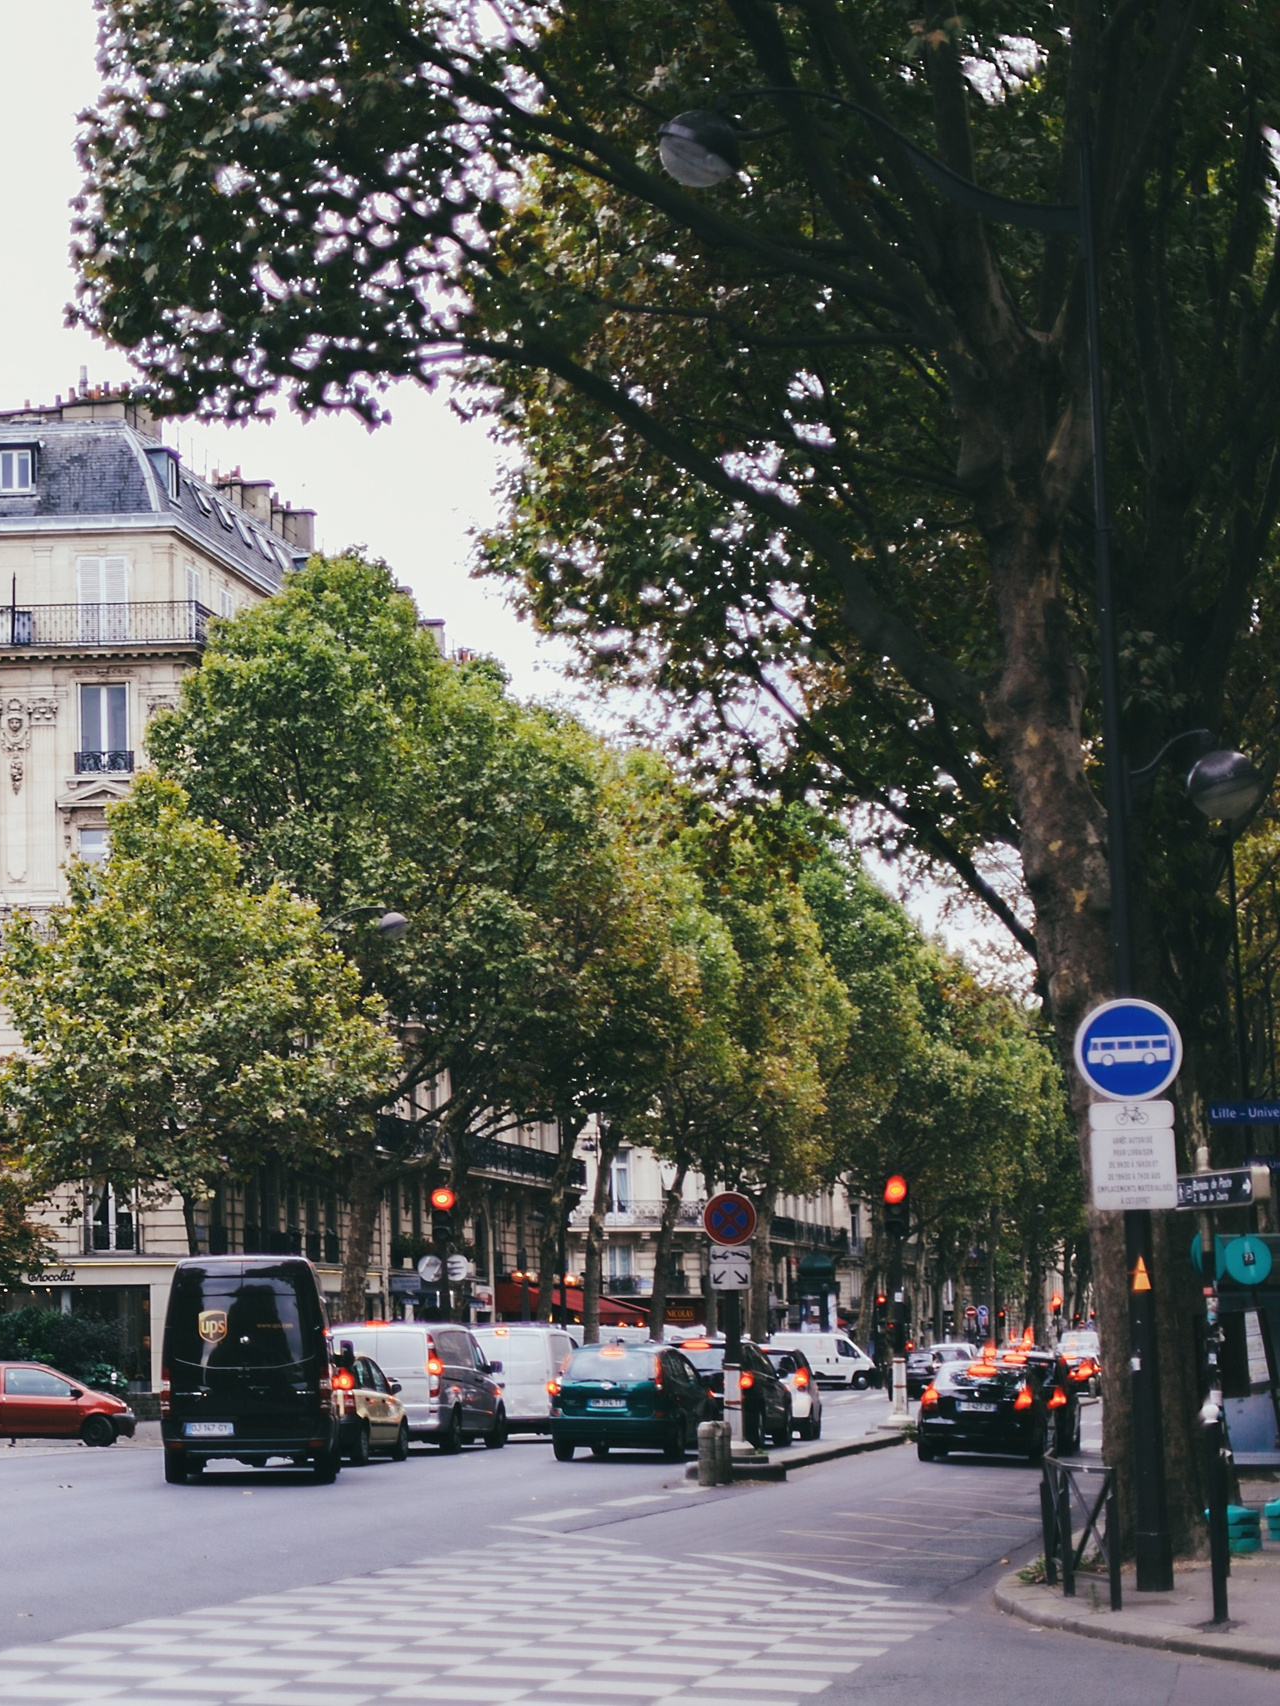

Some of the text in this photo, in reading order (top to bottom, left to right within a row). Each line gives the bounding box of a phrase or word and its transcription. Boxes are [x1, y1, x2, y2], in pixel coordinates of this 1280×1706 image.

[1211, 1108, 1237, 1118] Lille
[28, 1268, 75, 1282] Chocolat
[666, 1309, 694, 1318] NICOLAS
[201, 1320, 226, 1339] ups
